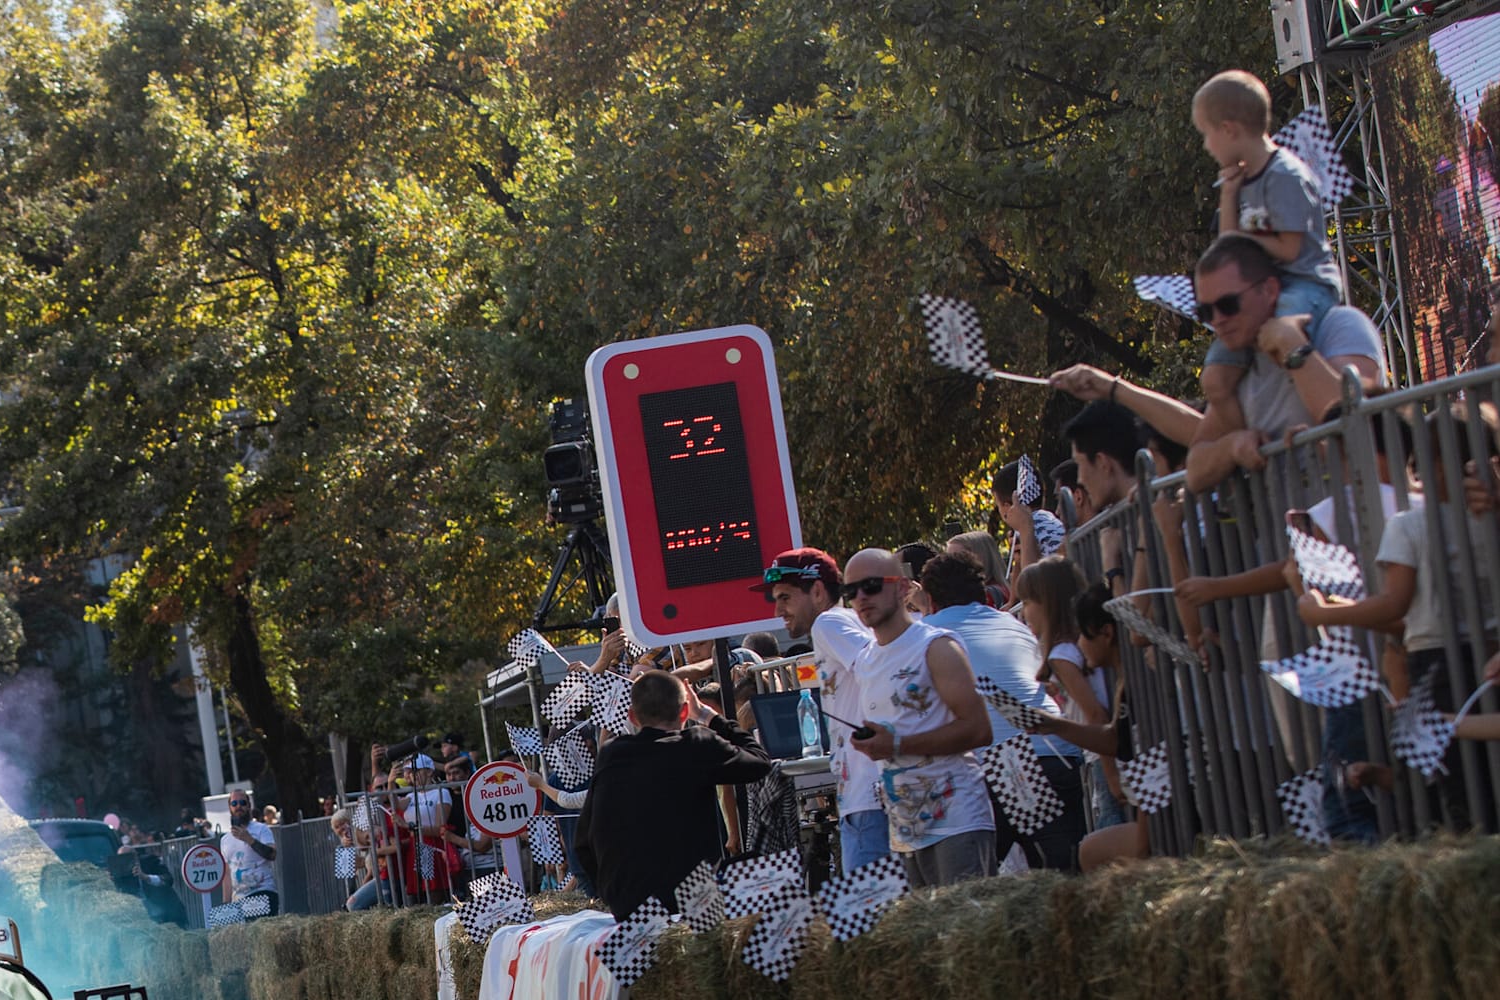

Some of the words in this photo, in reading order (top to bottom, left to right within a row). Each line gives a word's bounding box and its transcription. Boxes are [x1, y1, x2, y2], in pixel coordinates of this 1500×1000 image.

[663, 415, 725, 460] 32
[481, 786, 502, 800] Red
[503, 783, 524, 796] Bull
[483, 802, 507, 823] 48
[509, 803, 528, 819] m
[193, 869, 206, 883] 27
[208, 871, 218, 881] m
